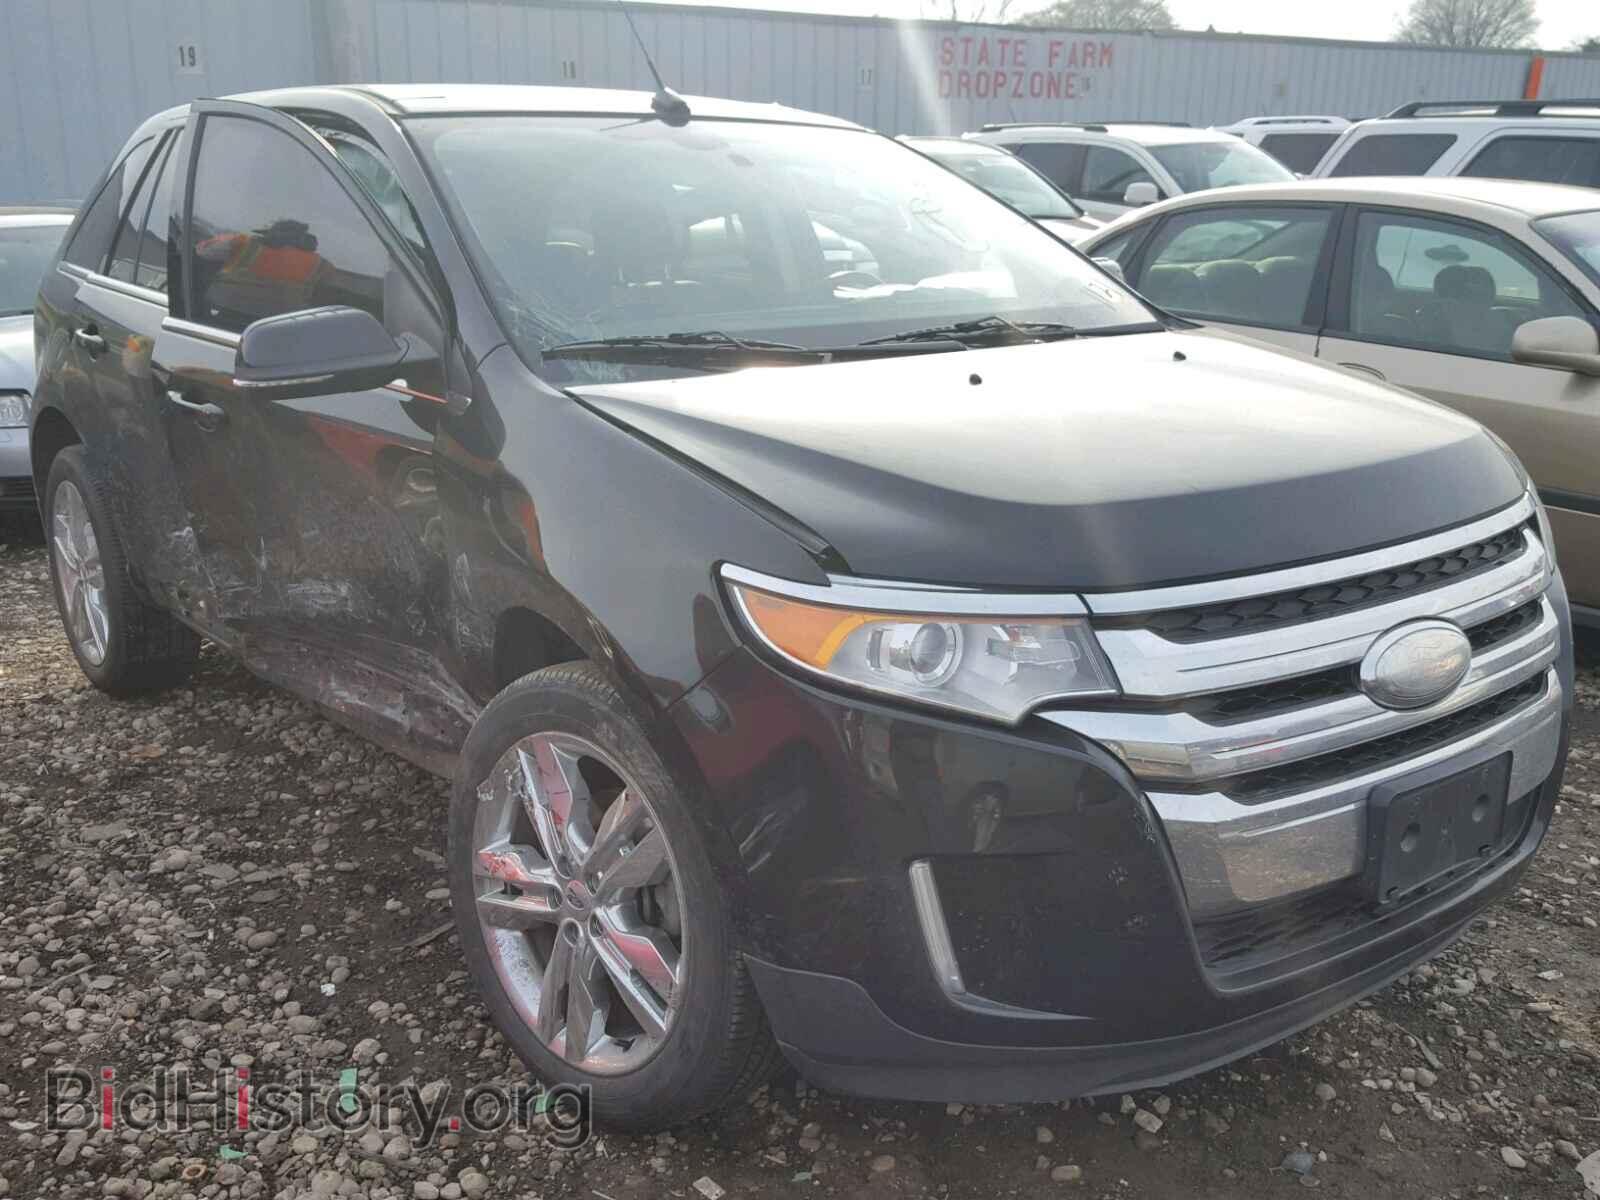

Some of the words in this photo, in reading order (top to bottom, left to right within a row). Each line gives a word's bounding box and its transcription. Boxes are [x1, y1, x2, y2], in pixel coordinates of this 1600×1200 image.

[178, 44, 197, 68] 19
[940, 36, 1027, 66] STATE
[1047, 39, 1115, 68] FARM
[938, 70, 1079, 99] DROPZONE
